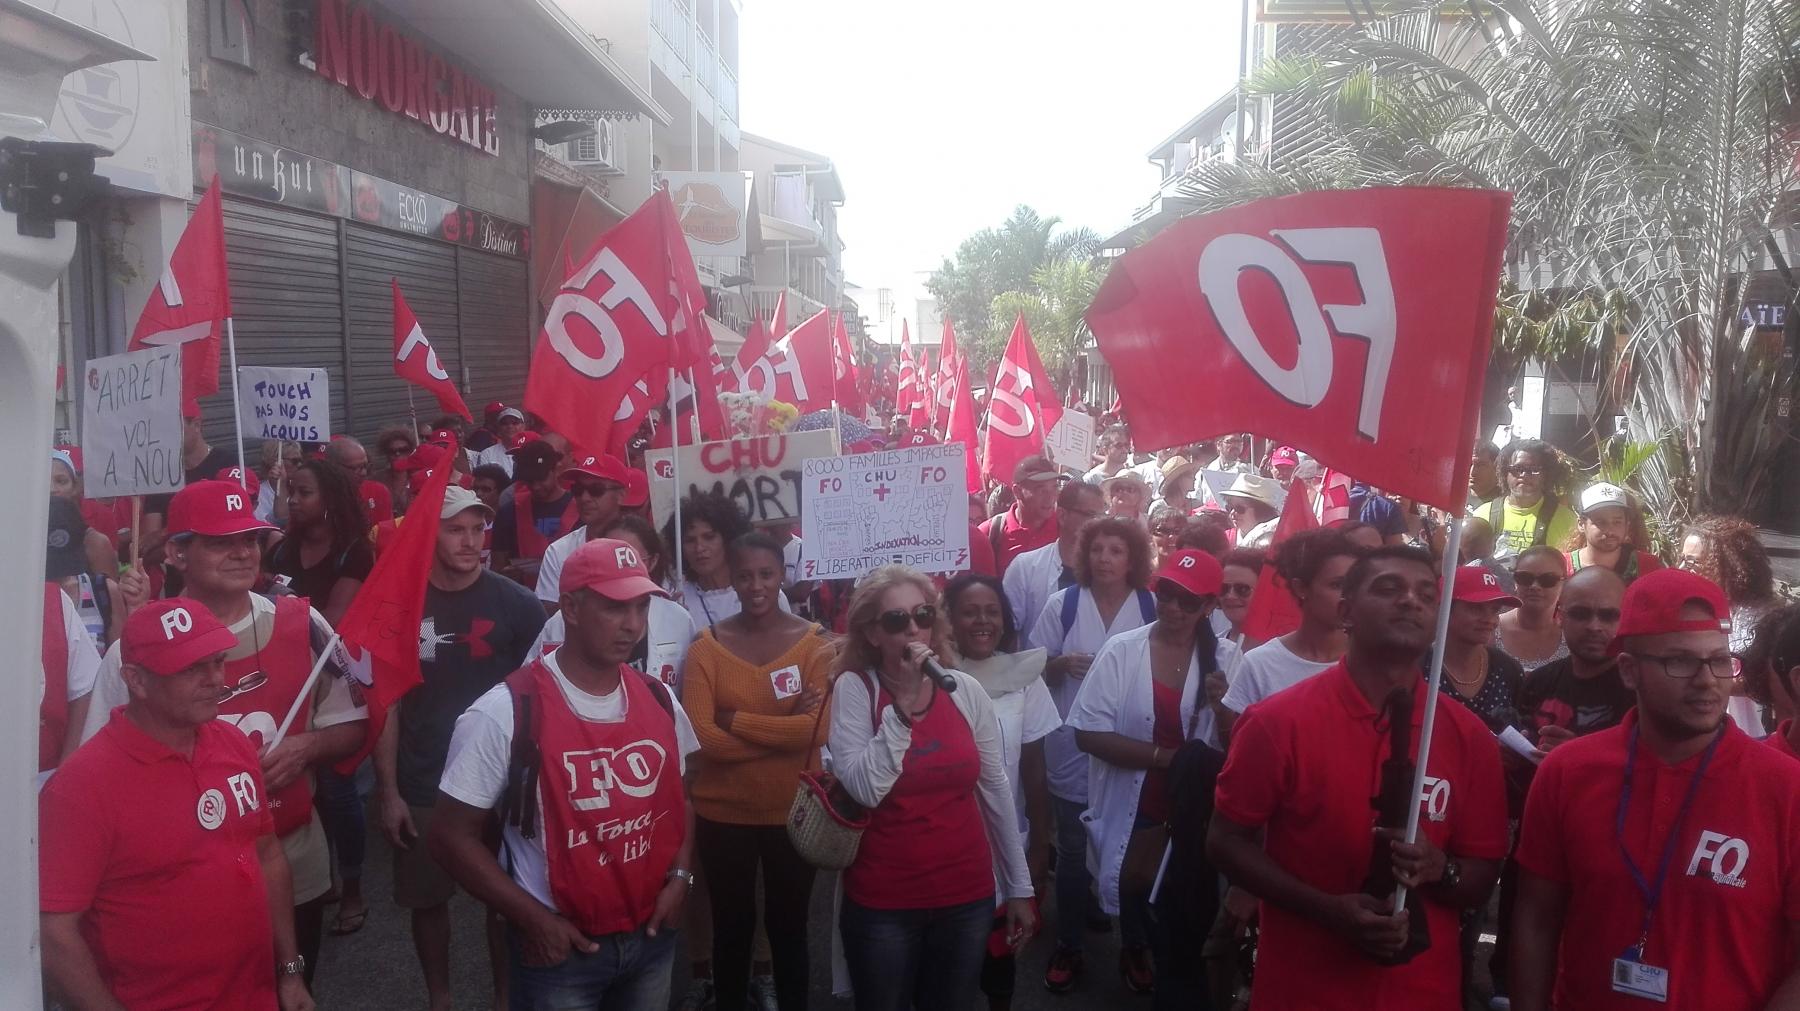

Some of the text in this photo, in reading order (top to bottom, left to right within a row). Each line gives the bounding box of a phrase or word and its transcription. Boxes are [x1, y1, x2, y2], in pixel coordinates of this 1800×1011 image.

[481, 213, 517, 255] Distinct
[255, 402, 309, 421] PAS NOS
[123, 419, 160, 451] VOL
[263, 424, 318, 440] ACQUIS
[911, 434, 923, 443] FO
[582, 457, 595, 466] FO
[701, 435, 787, 474] CHU
[805, 458, 844, 477] 8000
[849, 452, 901, 470] FAMILLES
[104, 448, 183, 487] A NOU
[819, 467, 946, 494] FO CHU FO
[226, 494, 243, 511] FO
[614, 546, 637, 568] FO
[816, 556, 890, 576] LIBERATION
[905, 550, 957, 566] DEFICIT
[1178, 555, 1195, 568] FO
[1483, 573, 1496, 585] FO
[160, 607, 193, 640] FO
[785, 678, 799, 694] FO
[563, 739, 667, 811] FO
[227, 771, 258, 817] FO
[203, 800, 215, 816] FO
[567, 828, 589, 848] La
[1686, 829, 1750, 879] FO
